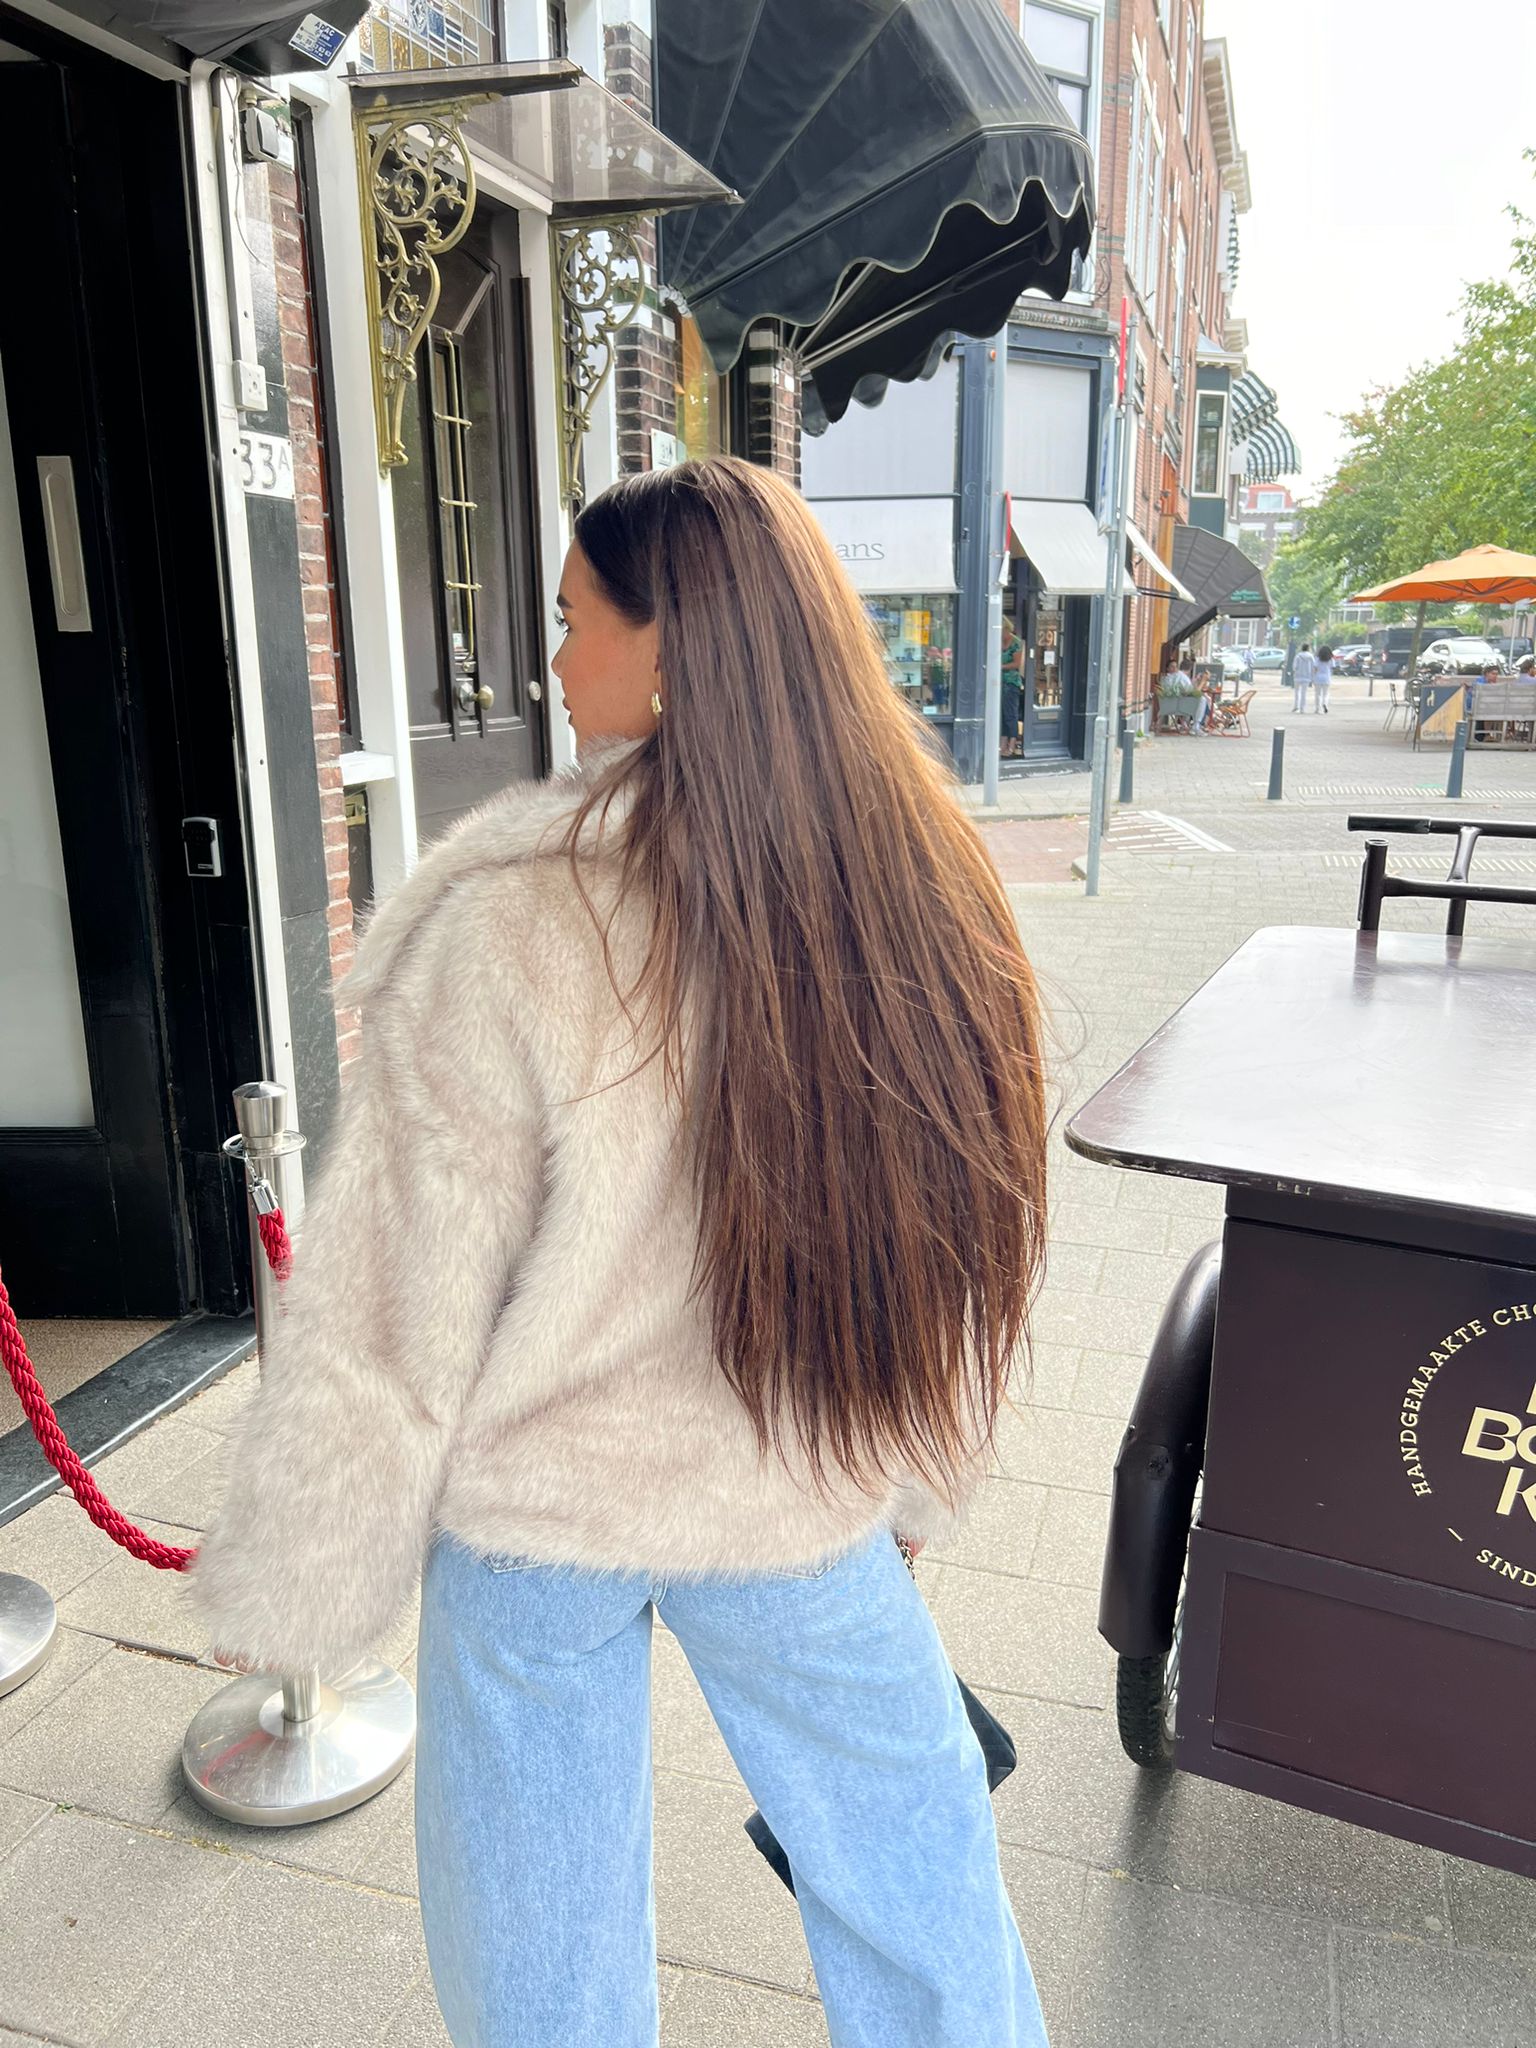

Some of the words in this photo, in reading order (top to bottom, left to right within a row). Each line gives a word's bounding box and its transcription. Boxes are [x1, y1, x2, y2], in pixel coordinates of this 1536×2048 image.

[1400, 1319, 1488, 1497] HANDGEMAAKTE
[1492, 1303, 1536, 1326] CH
[1475, 1549, 1536, 1587] SIND
